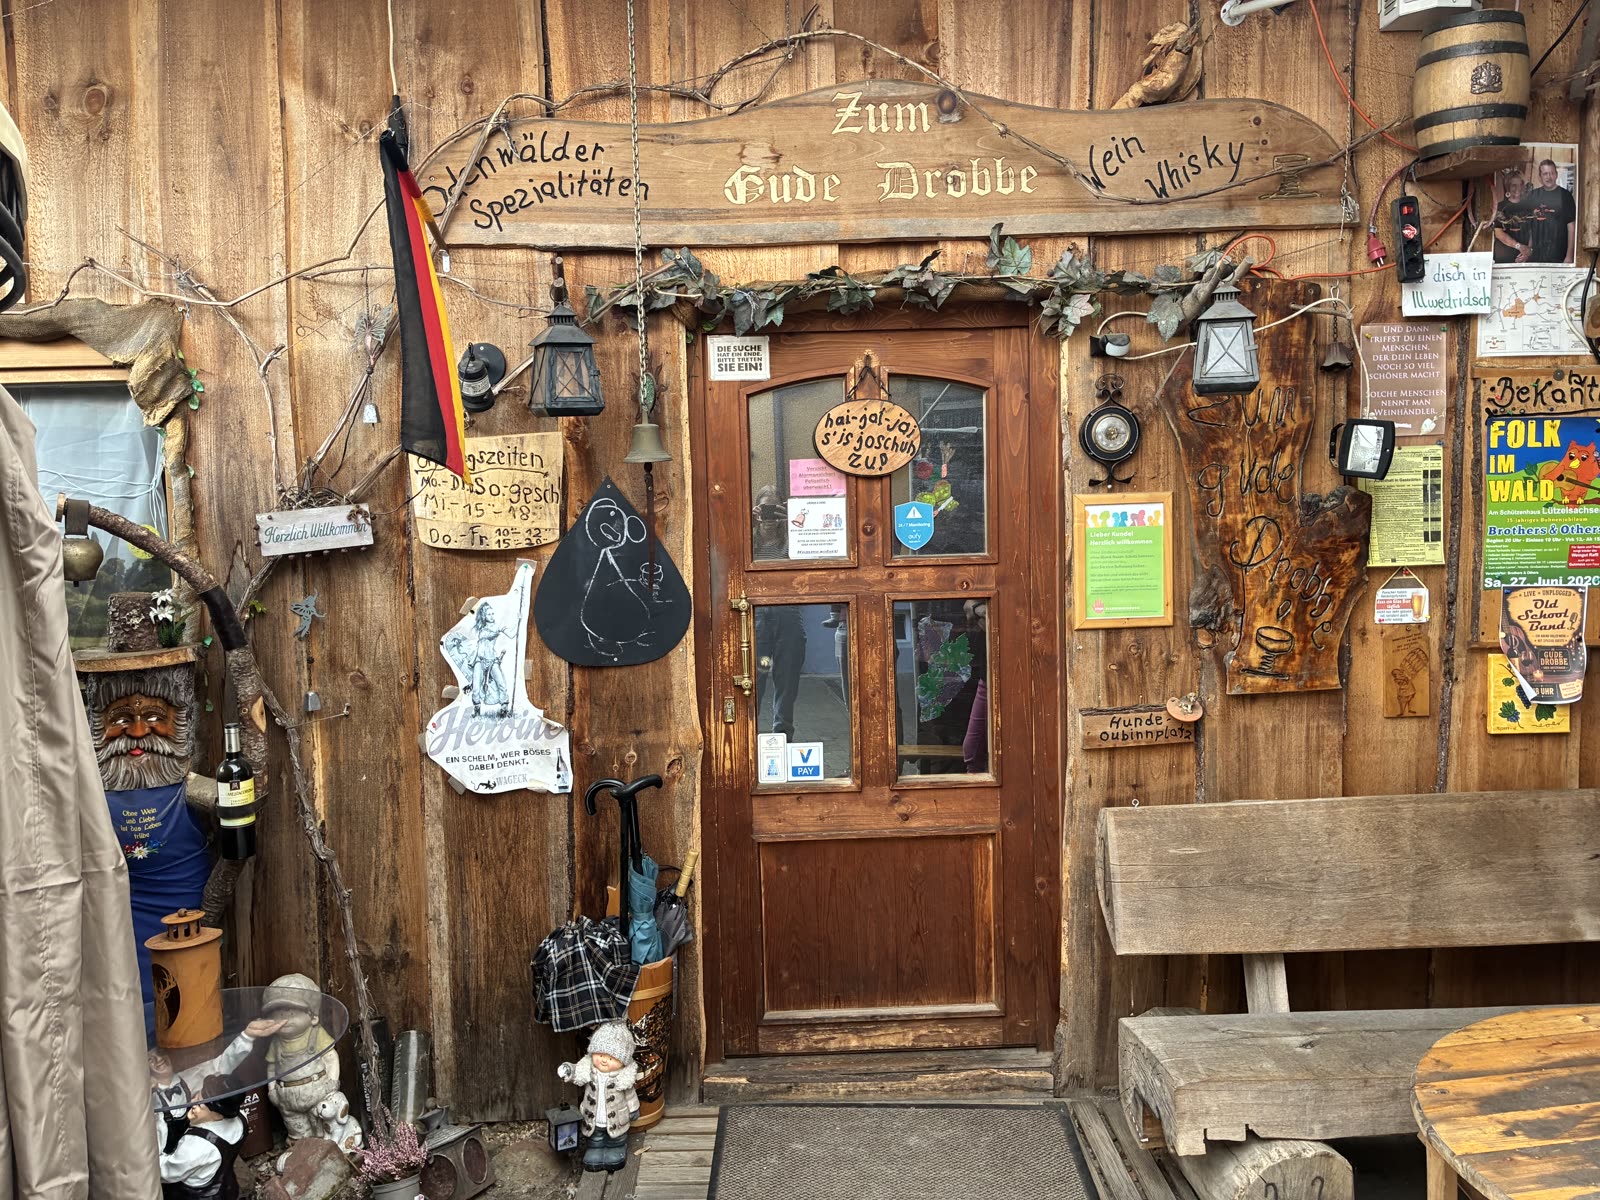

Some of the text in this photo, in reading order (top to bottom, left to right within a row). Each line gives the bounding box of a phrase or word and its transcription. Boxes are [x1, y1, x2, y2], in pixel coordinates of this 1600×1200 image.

[831, 91, 931, 135] Zum
[1145, 135, 1244, 199] Whisky
[422, 131, 605, 218] Odenwälder
[723, 156, 1039, 205] Gude Drobbe
[470, 167, 650, 232] Spezialitäten
[1473, 268, 1486, 281] in
[1383, 325, 1430, 334] UND DANN
[1403, 334, 1416, 342] DU
[1418, 334, 1443, 342] EINEN
[733, 344, 763, 352] SUCHE
[1372, 352, 1440, 362] DER DEIN LEBEN
[717, 362, 763, 372] SIE EIN!
[1376, 363, 1402, 371] NOCH
[1404, 362, 1416, 370] SO
[1368, 371, 1409, 380] SCHÖNER
[1400, 389, 1447, 397] MENSCHEN
[1381, 398, 1431, 407] NENNT MAN
[1490, 420, 1561, 449] FOLK
[1489, 455, 1515, 474] IM
[1489, 480, 1555, 502] WALD
[1542, 506, 1600, 515] Lützelsachse
[264, 521, 369, 544] Herzlich Willkommen
[1488, 524, 1600, 536] Brothers & Others
[1116, 538, 1153, 546] willkommen
[1229, 515, 1333, 650] Drobbe
[1534, 576, 1563, 586] Juni
[1542, 589, 1572, 597] UNPLUGGED
[1532, 599, 1559, 609] Old
[1517, 608, 1569, 621] School
[1528, 620, 1566, 631] Band
[1540, 658, 1568, 666] DROBBE
[1540, 687, 1554, 696] UHR
[428, 706, 565, 757] Heroine
[445, 747, 552, 764] EIN SCHELM, WER BÖSES
[468, 759, 530, 772] DABEI DENKT.
[797, 767, 814, 776] PAY
[495, 773, 529, 787] WAGECK
[122, 807, 157, 817] Ohne Wein
